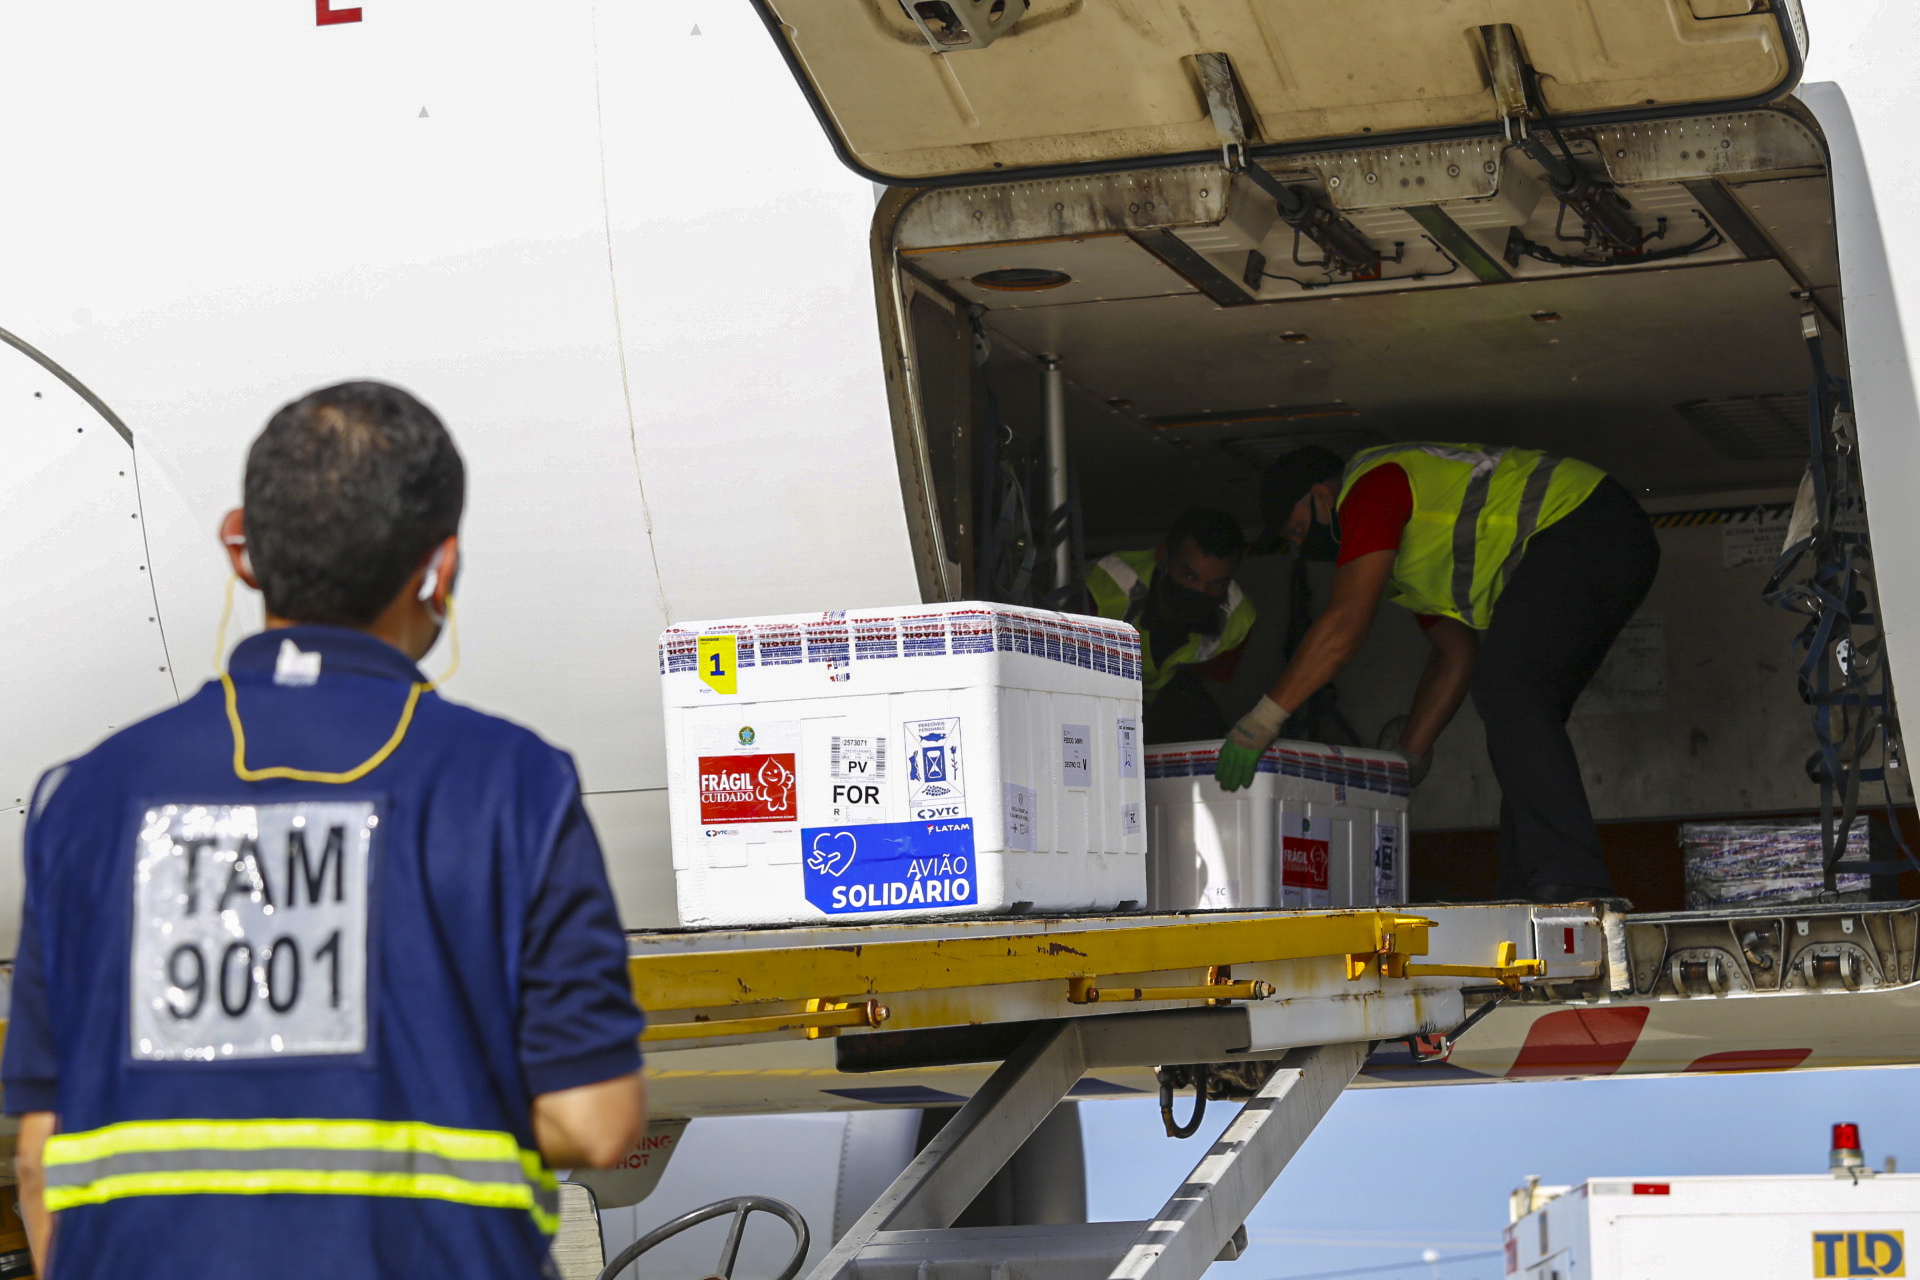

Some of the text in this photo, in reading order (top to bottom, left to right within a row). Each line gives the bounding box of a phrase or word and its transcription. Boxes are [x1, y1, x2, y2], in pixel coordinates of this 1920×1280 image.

[710, 653, 725, 676] 1
[848, 760, 868, 773] PV
[701, 769, 754, 791] FRÁGIL
[701, 792, 754, 803] CUIDADO
[833, 784, 880, 805] FOR
[935, 823, 970, 833] LATAM
[907, 853, 968, 878] AVIÃO
[1284, 847, 1309, 864] FRÁGIL
[173, 825, 345, 914] TAM
[832, 874, 970, 909] SOLIDÁRIO
[166, 930, 343, 1020] 9001
[616, 1153, 650, 1170] HOT
[1815, 1233, 1902, 1276] TLD
